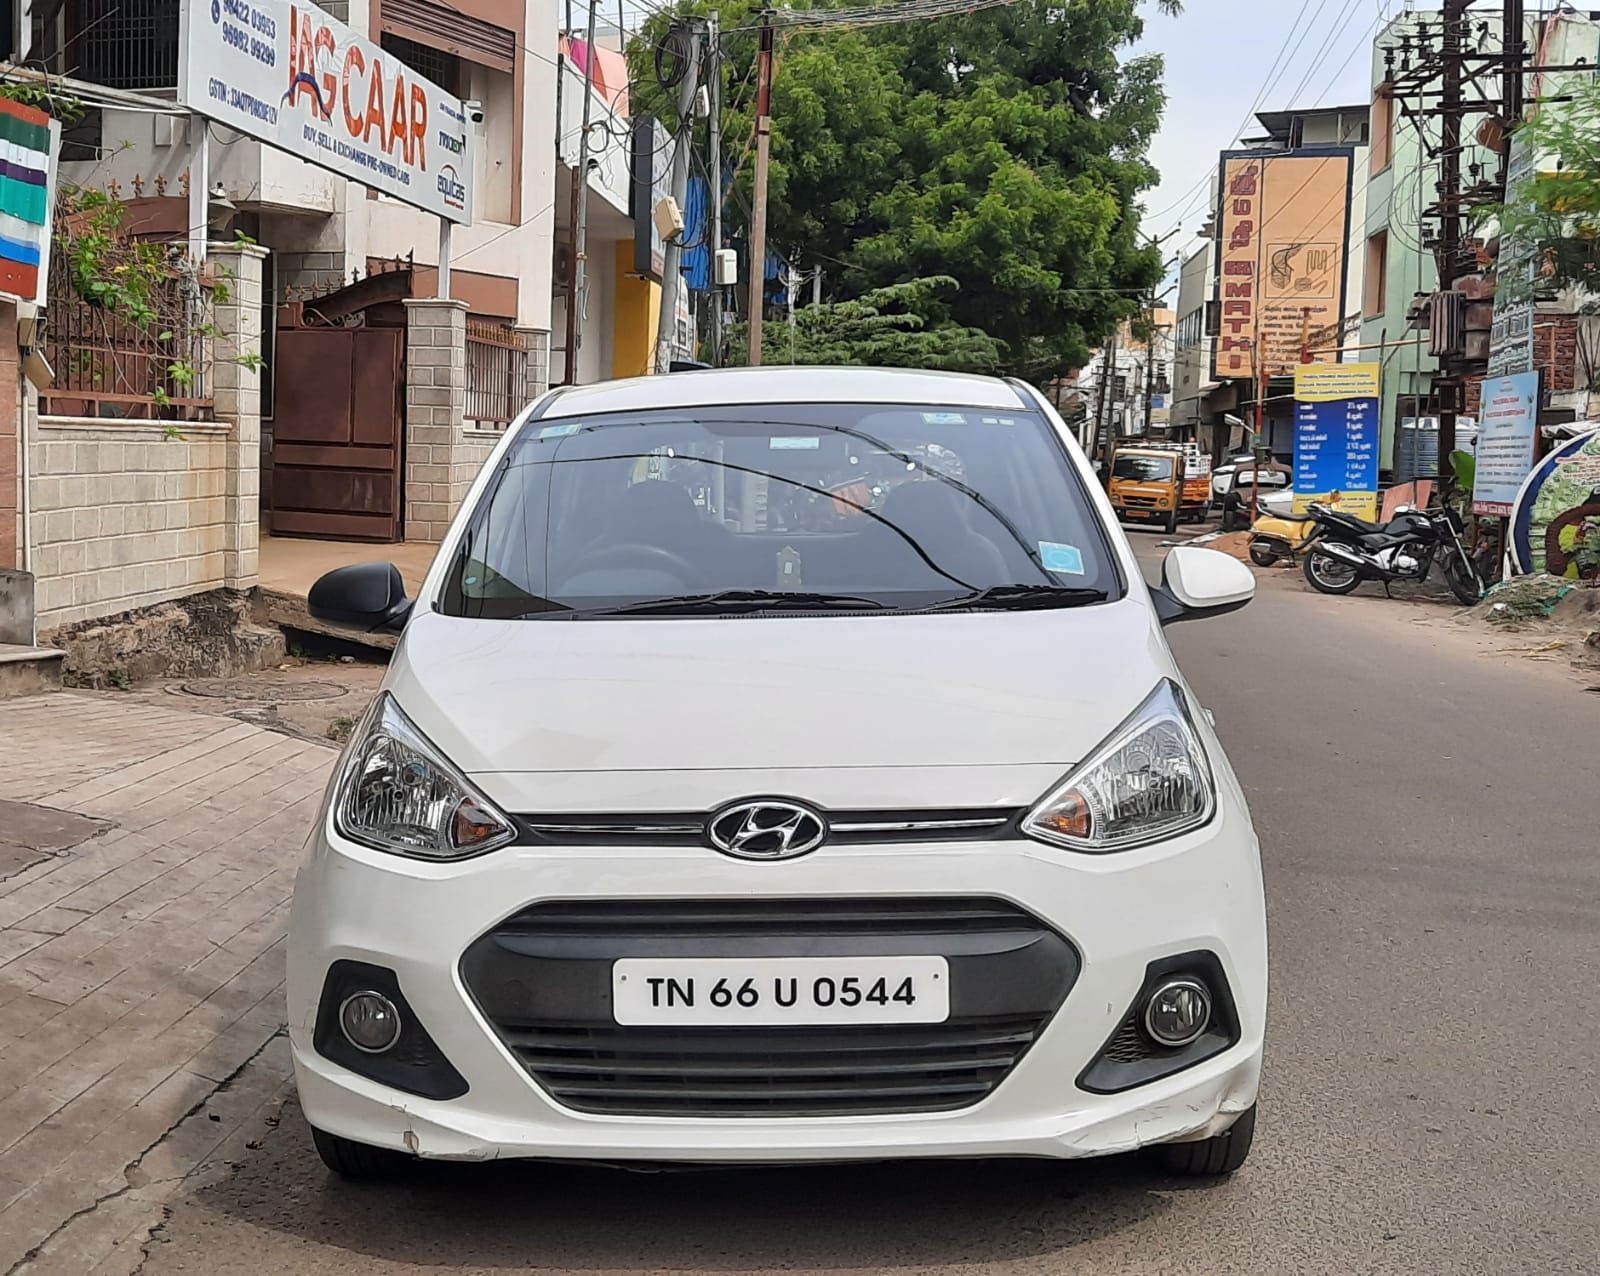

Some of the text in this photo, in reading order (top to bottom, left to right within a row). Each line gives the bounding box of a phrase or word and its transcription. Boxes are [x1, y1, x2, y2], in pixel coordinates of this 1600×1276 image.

[251, 9, 275, 39] 03953
[222, 21, 275, 67] 96982 99299
[208, 77, 227, 102] GSTIN
[337, 141, 367, 166] EXCHANGE
[646, 977, 916, 1007] TN 66 U 0544
